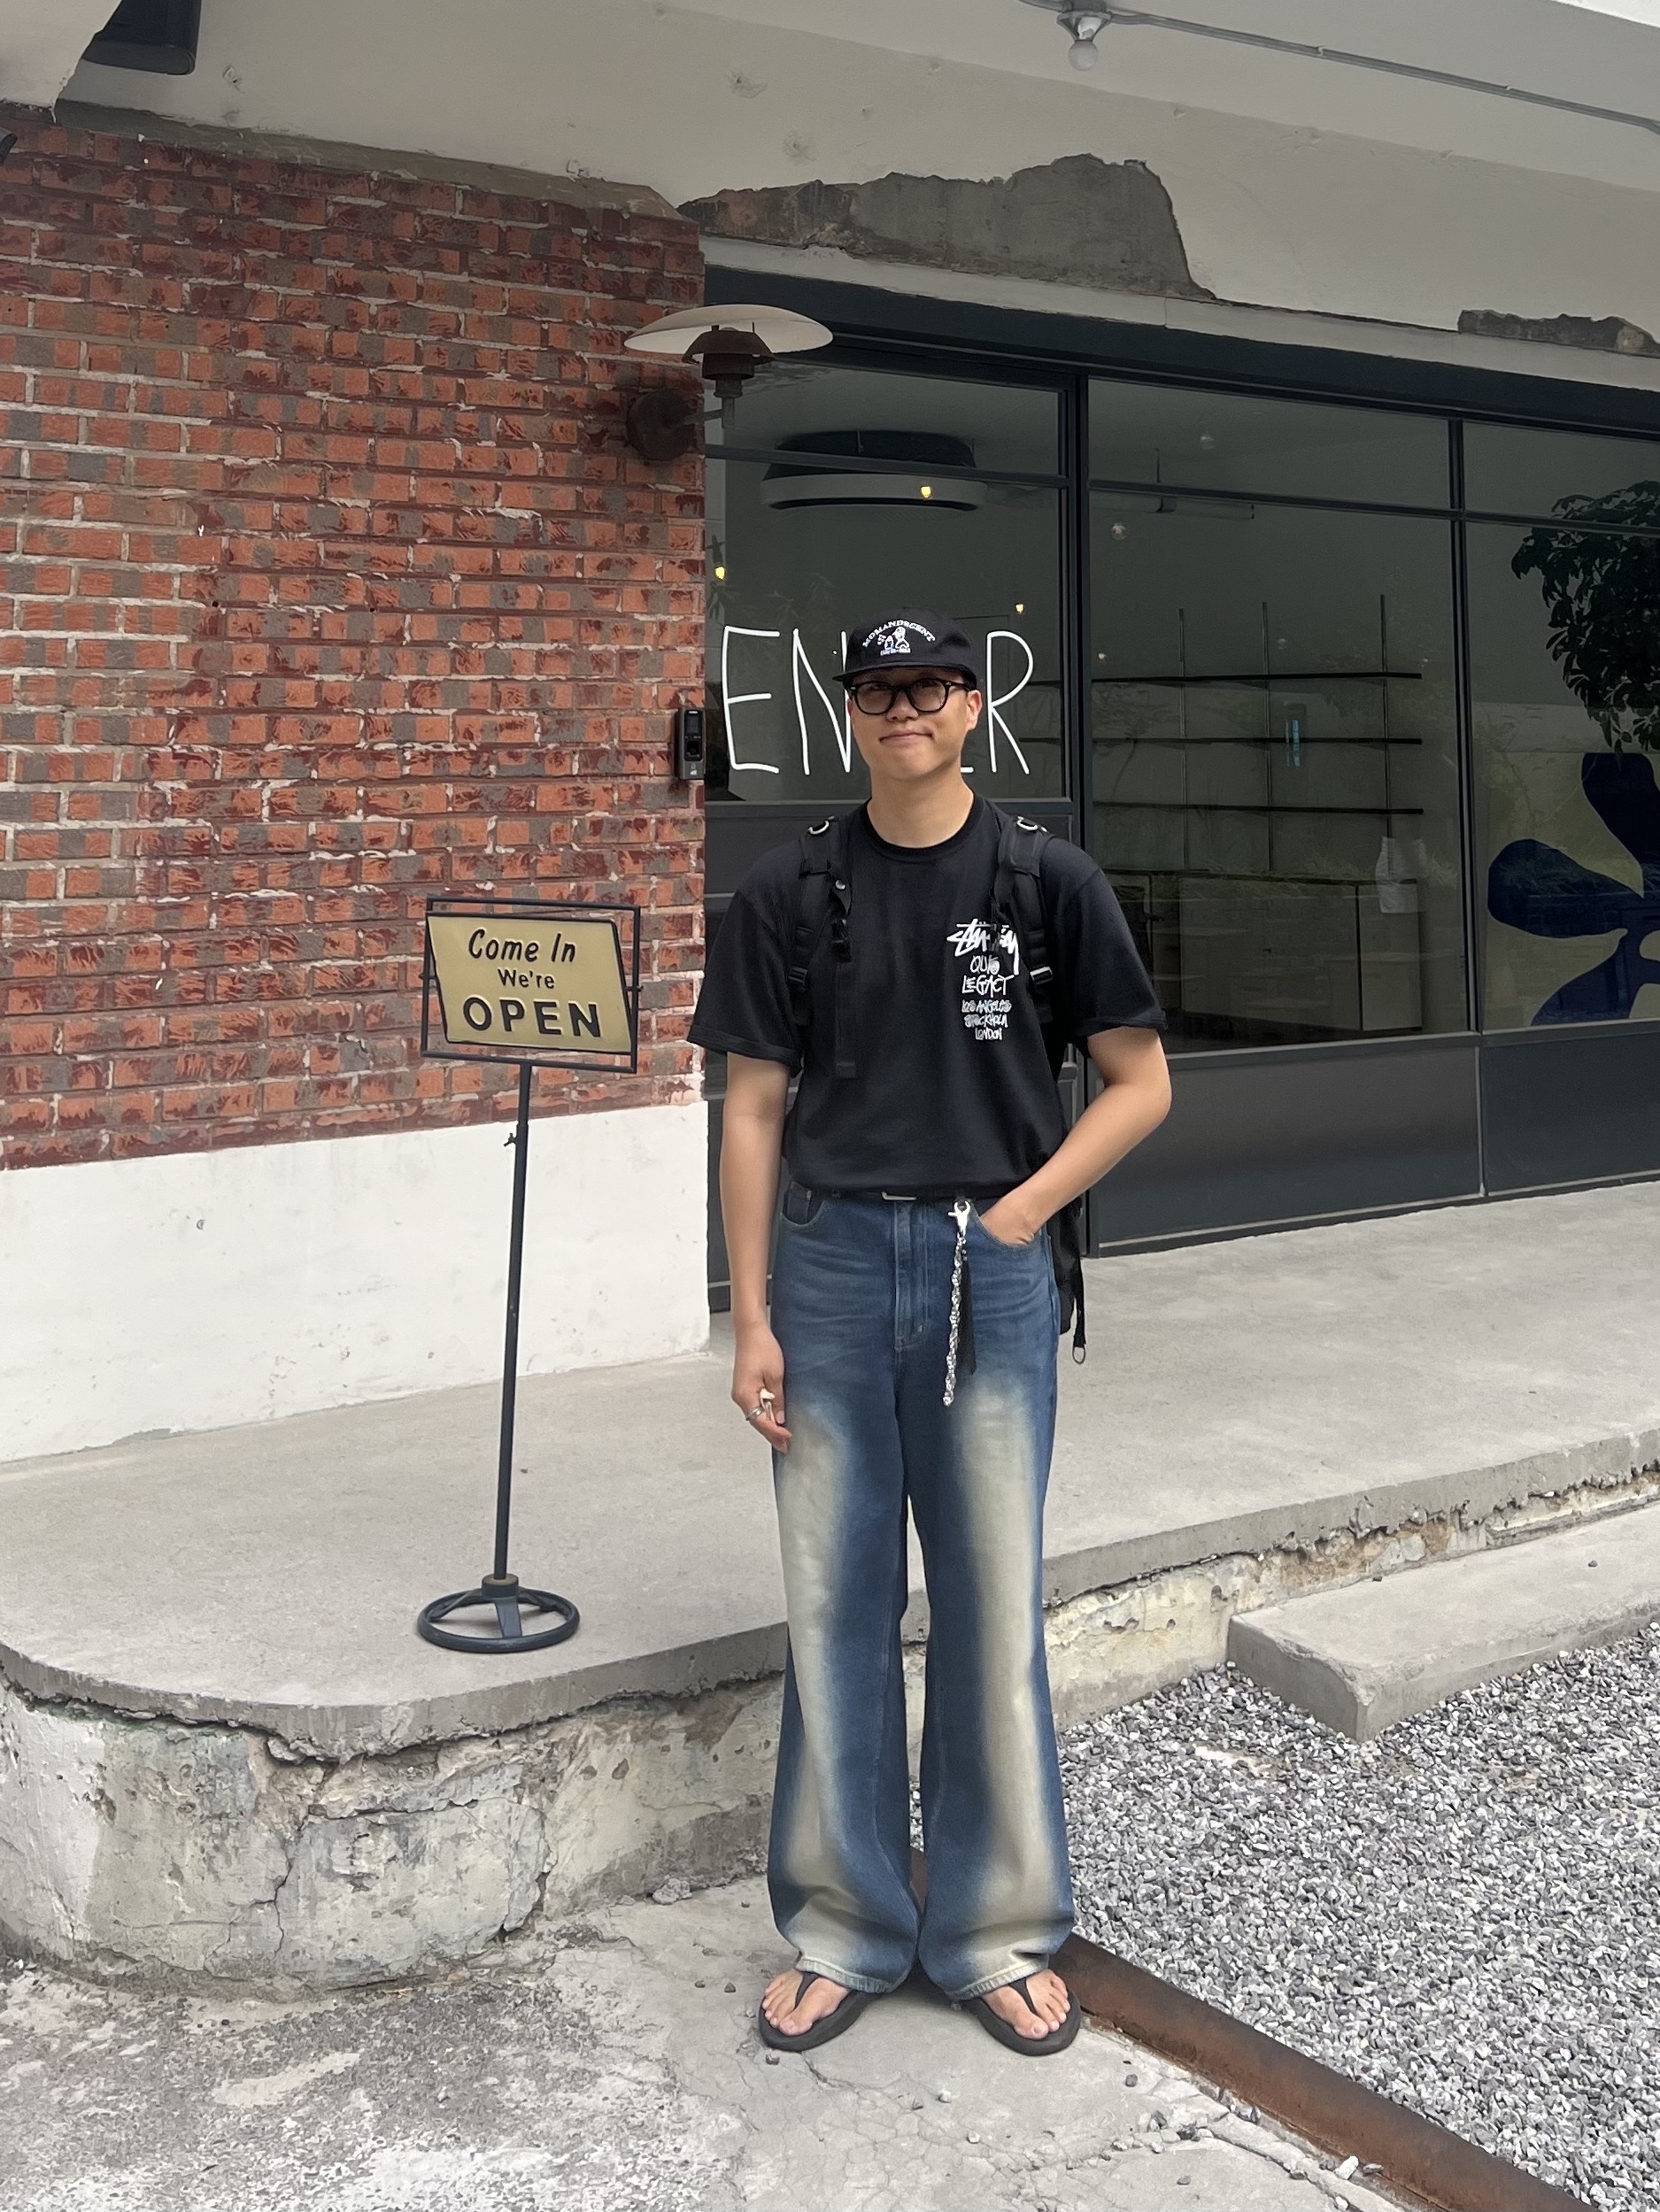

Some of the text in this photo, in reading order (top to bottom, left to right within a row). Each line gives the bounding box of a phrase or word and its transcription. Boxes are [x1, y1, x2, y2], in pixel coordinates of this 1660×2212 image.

[722, 625, 1034, 775] ENR
[468, 929, 576, 963] Come In
[498, 967, 555, 990] We're
[463, 997, 601, 1038] OPEN
